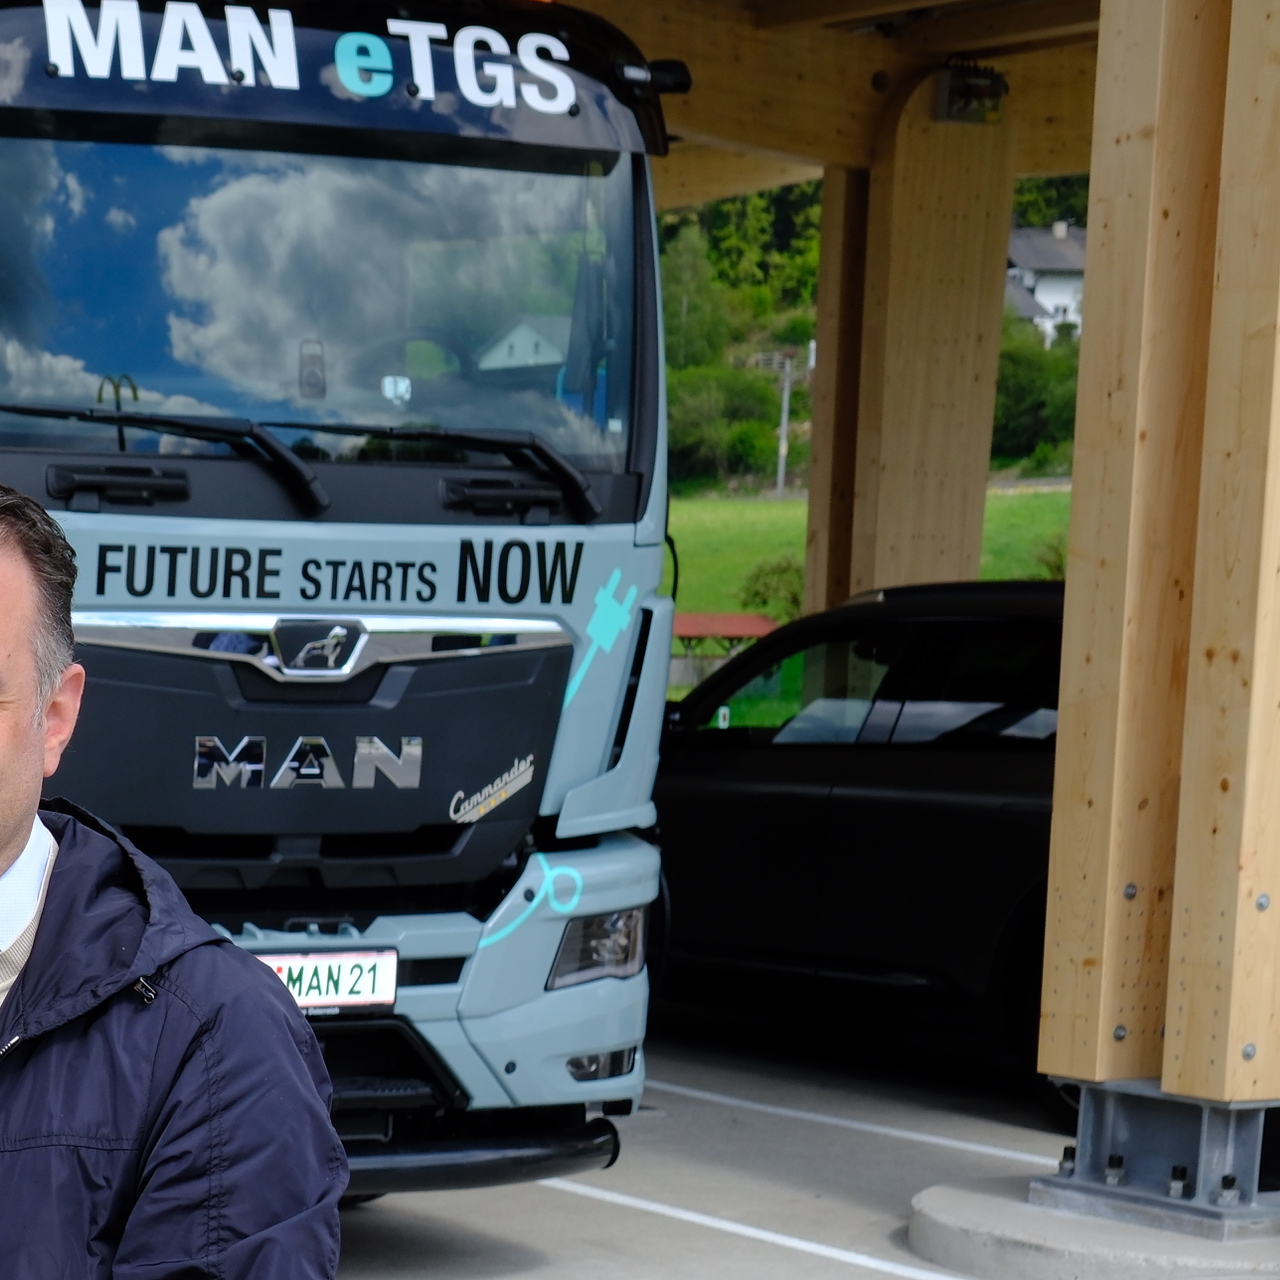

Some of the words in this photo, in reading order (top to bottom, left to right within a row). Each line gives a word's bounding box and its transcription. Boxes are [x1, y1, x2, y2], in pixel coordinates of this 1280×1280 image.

[42, 0, 300, 90] MAN
[334, 18, 578, 115] eTGS
[95, 544, 283, 599] FUTURE
[299, 559, 438, 602] STARTS
[456, 538, 585, 605] NOW
[193, 736, 423, 789] MAN
[287, 963, 341, 997] MAN
[348, 962, 377, 995] 21
